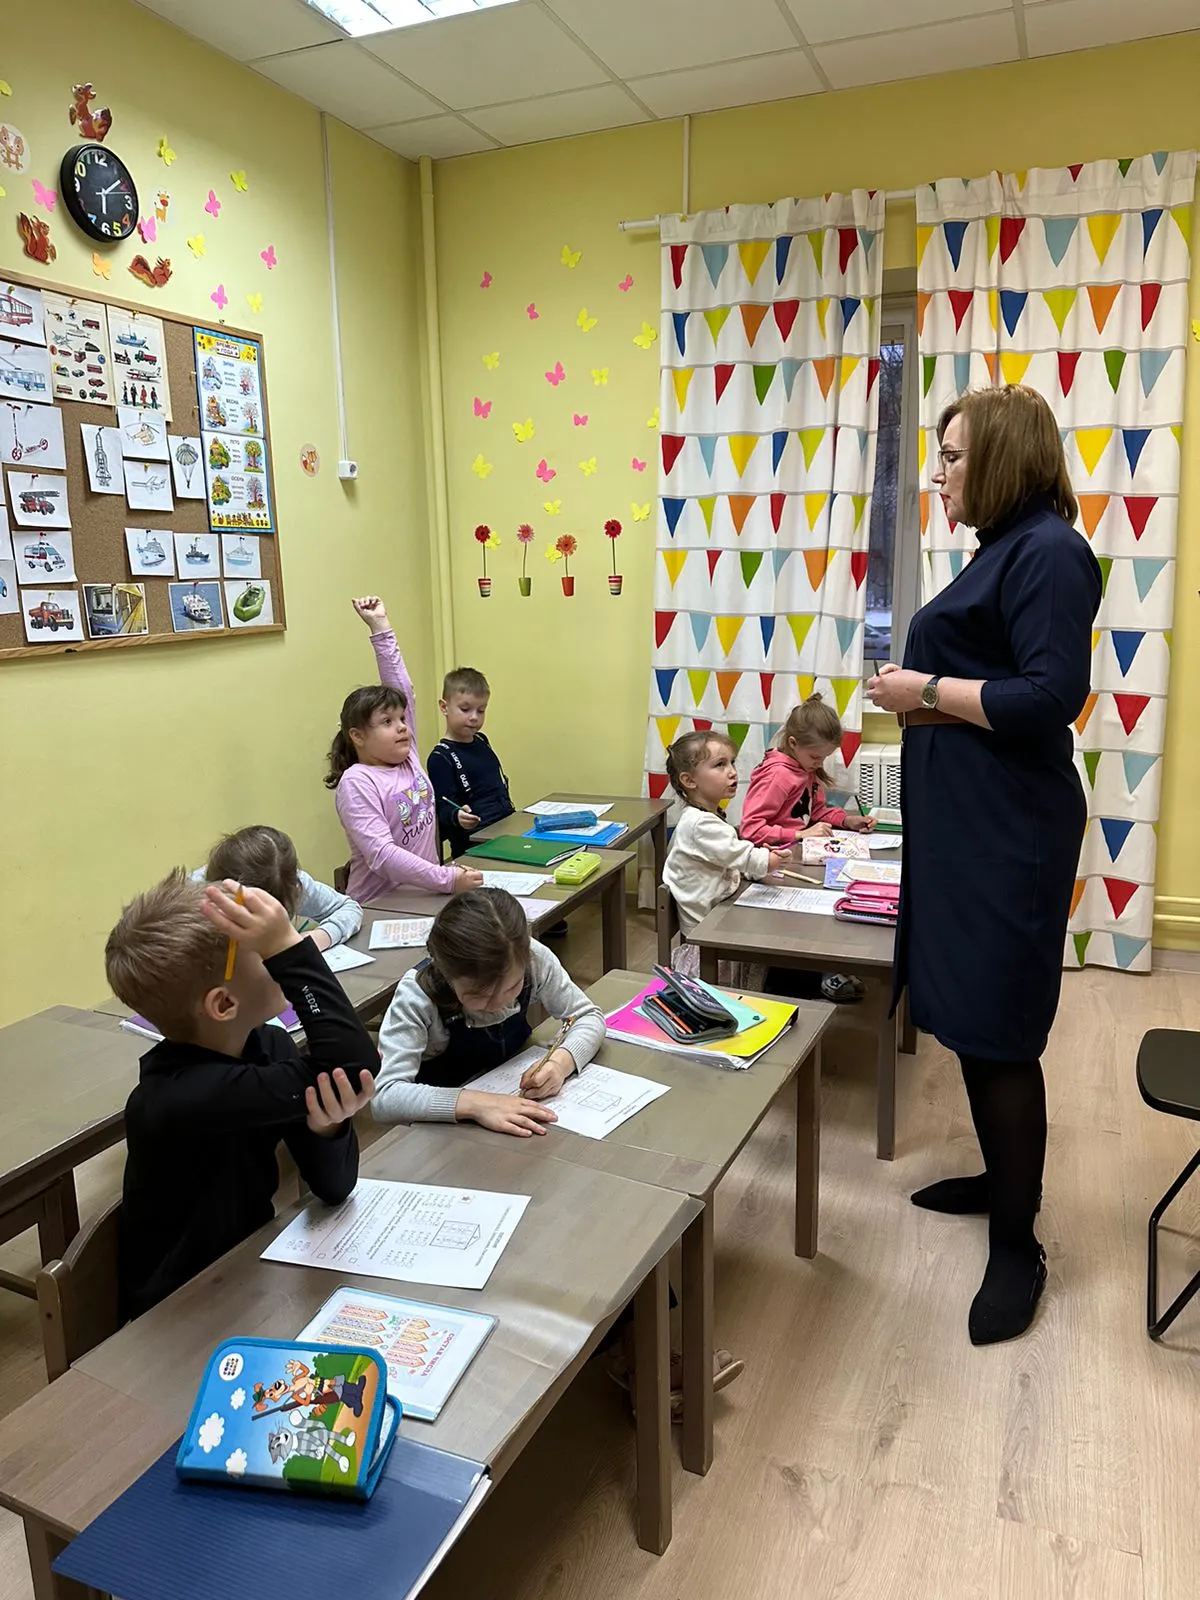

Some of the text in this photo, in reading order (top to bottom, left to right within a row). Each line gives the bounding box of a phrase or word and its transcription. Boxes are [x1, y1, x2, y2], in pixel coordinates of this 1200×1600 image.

[93, 151, 108, 167] 12
[124, 195, 133, 210] 3
[122, 213, 131, 228] 4
[101, 222, 111, 236] 6
[112, 221, 122, 237] 5
[302, 985, 321, 1015] WEDZE
[435, 1332, 455, 1356] СОСТАВ
